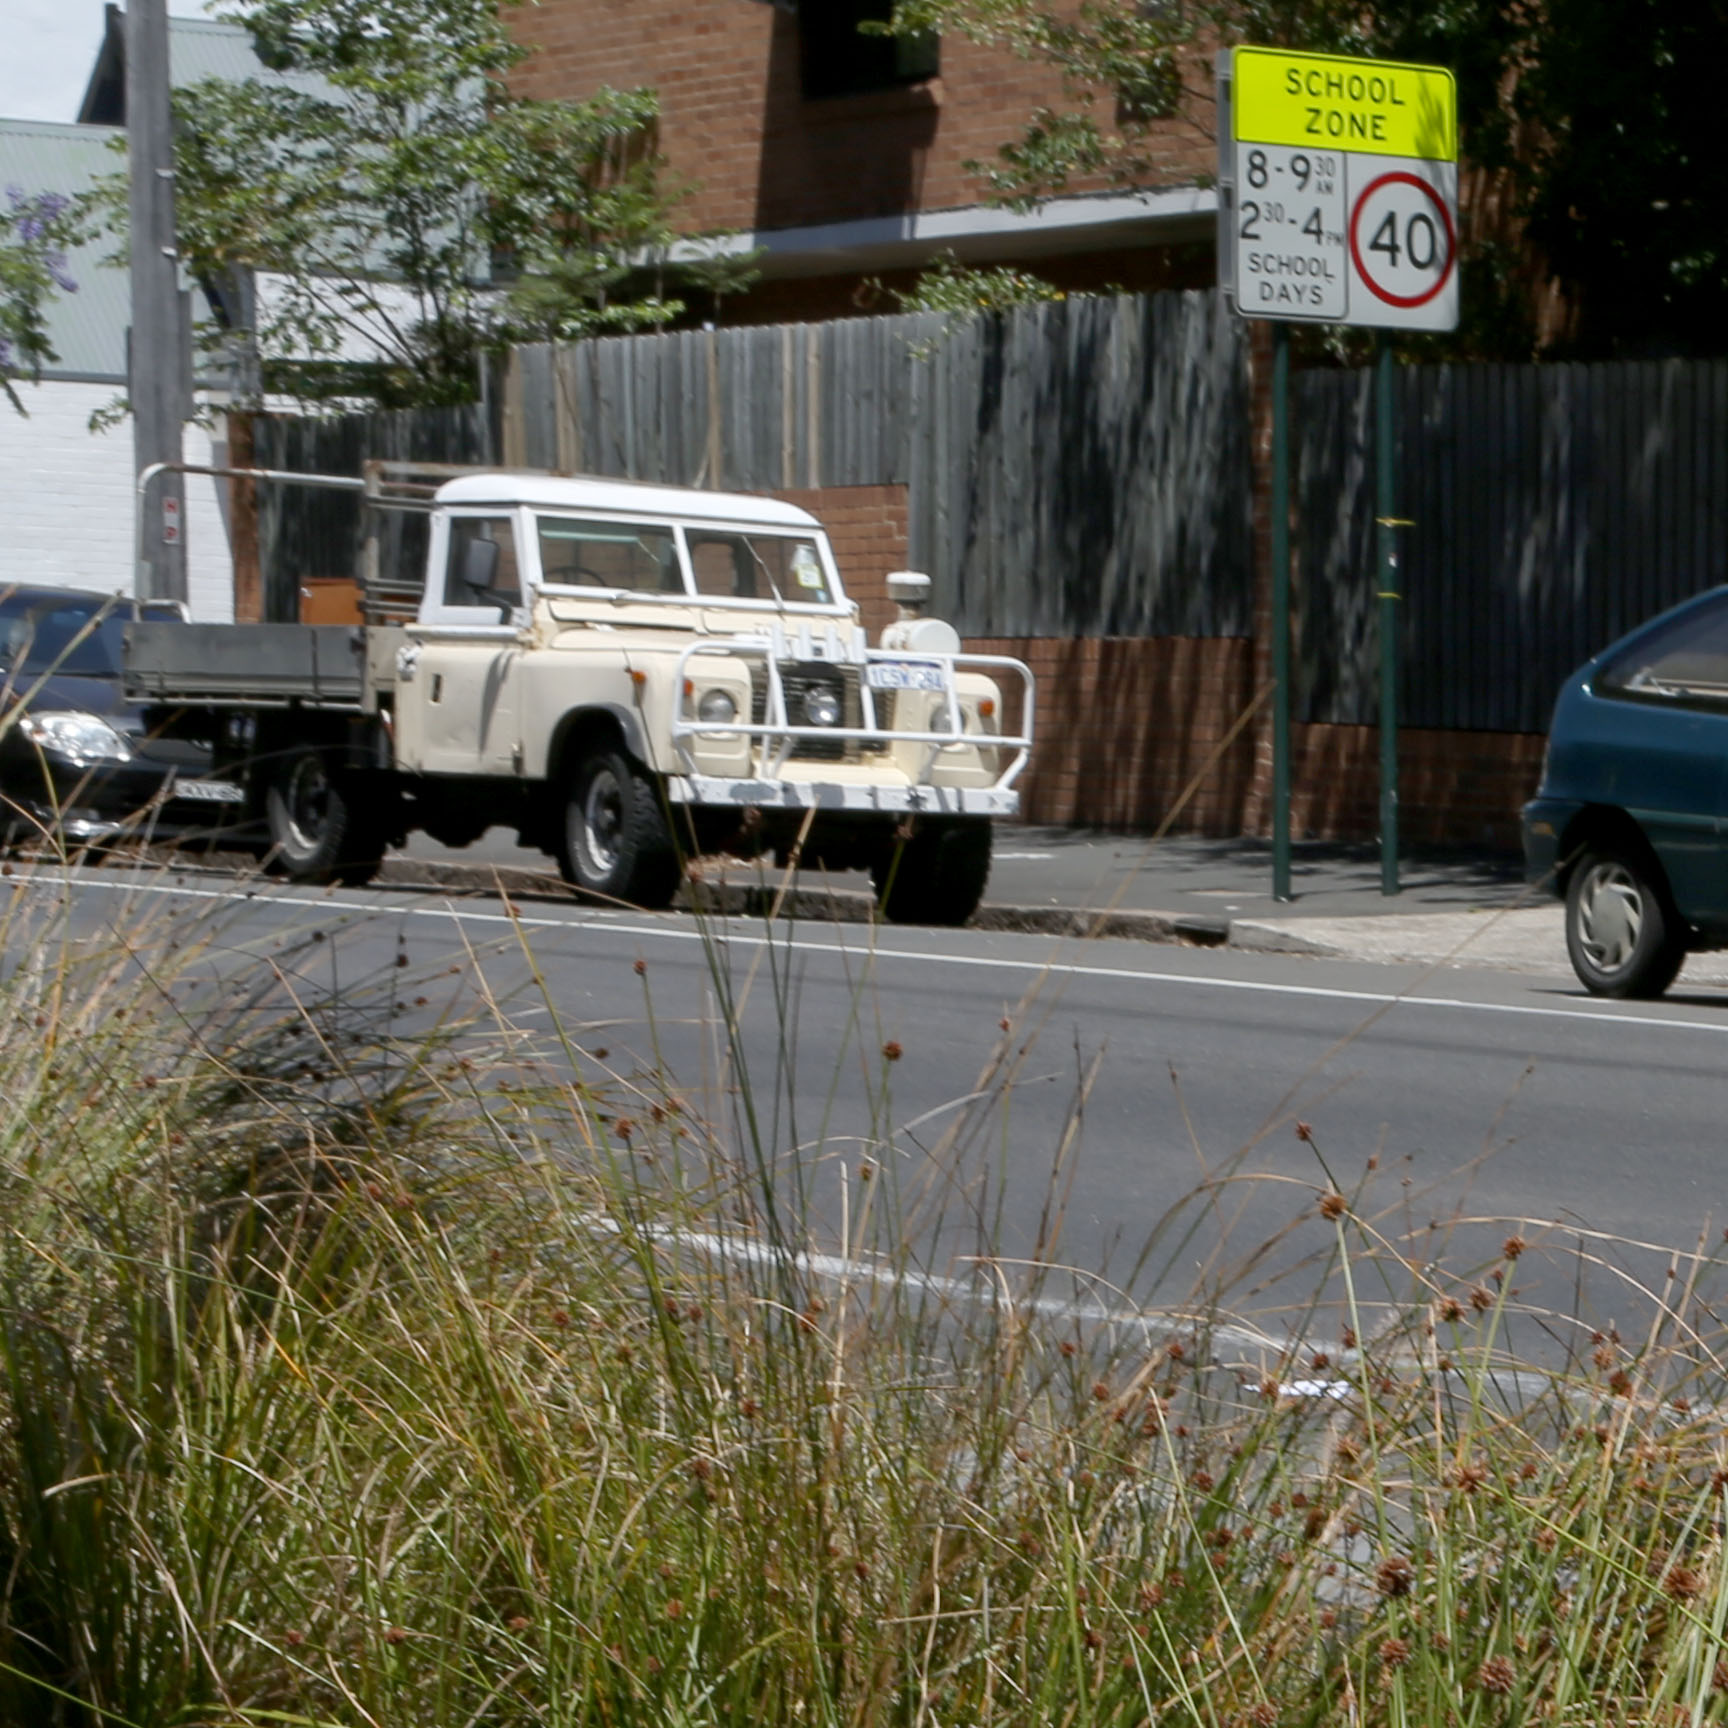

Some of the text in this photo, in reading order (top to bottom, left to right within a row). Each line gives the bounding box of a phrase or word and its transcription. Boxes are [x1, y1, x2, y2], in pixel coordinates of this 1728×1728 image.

[1285, 68, 1406, 106] SCHOOL
[1304, 107, 1387, 141] ZONE
[1368, 210, 1437, 270] 40
[1248, 252, 1335, 280] SCHOOL
[1259, 281, 1323, 305] DAYS
